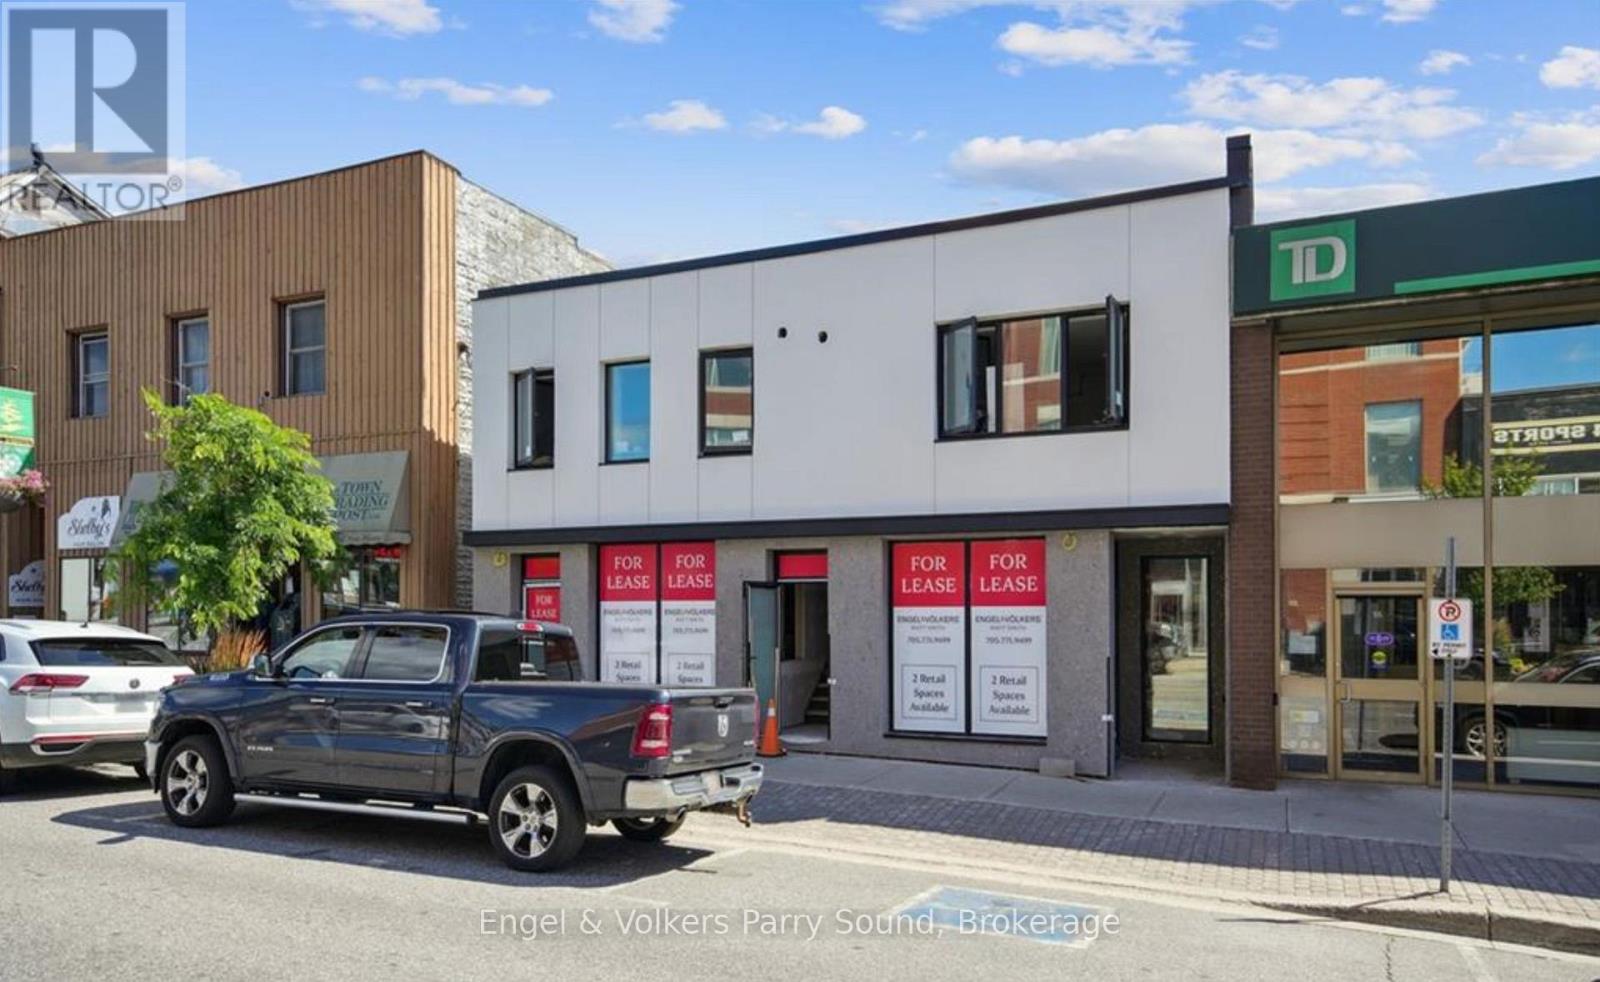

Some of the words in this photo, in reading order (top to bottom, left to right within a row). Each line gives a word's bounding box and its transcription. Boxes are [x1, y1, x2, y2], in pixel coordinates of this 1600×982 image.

[1278, 236, 1347, 284] TD
[342, 480, 382, 494] TOWN
[336, 494, 388, 508] RADING
[67, 517, 111, 539] Shelby's
[614, 556, 643, 570] FOR
[675, 554, 706, 569] FOR
[910, 556, 947, 572] FOR
[989, 554, 1028, 571] FOR
[606, 575, 651, 590] LEASE
[667, 573, 714, 589] LEASE
[901, 577, 957, 594] LEASE
[979, 576, 1039, 593] LEASE
[535, 594, 553, 605] FOR
[531, 608, 558, 619] LEASE
[621, 660, 642, 670] Retail
[683, 662, 705, 671] Retail
[616, 672, 642, 684] Spaces
[677, 675, 704, 686] Spaces
[912, 673, 918, 683] 2
[919, 673, 947, 684] Retail
[991, 675, 998, 685] 2
[999, 675, 1027, 686] Retail
[913, 688, 945, 699] Spaces
[992, 690, 1026, 702] Spaces
[909, 703, 950, 713] Available
[988, 705, 1031, 716] Available
